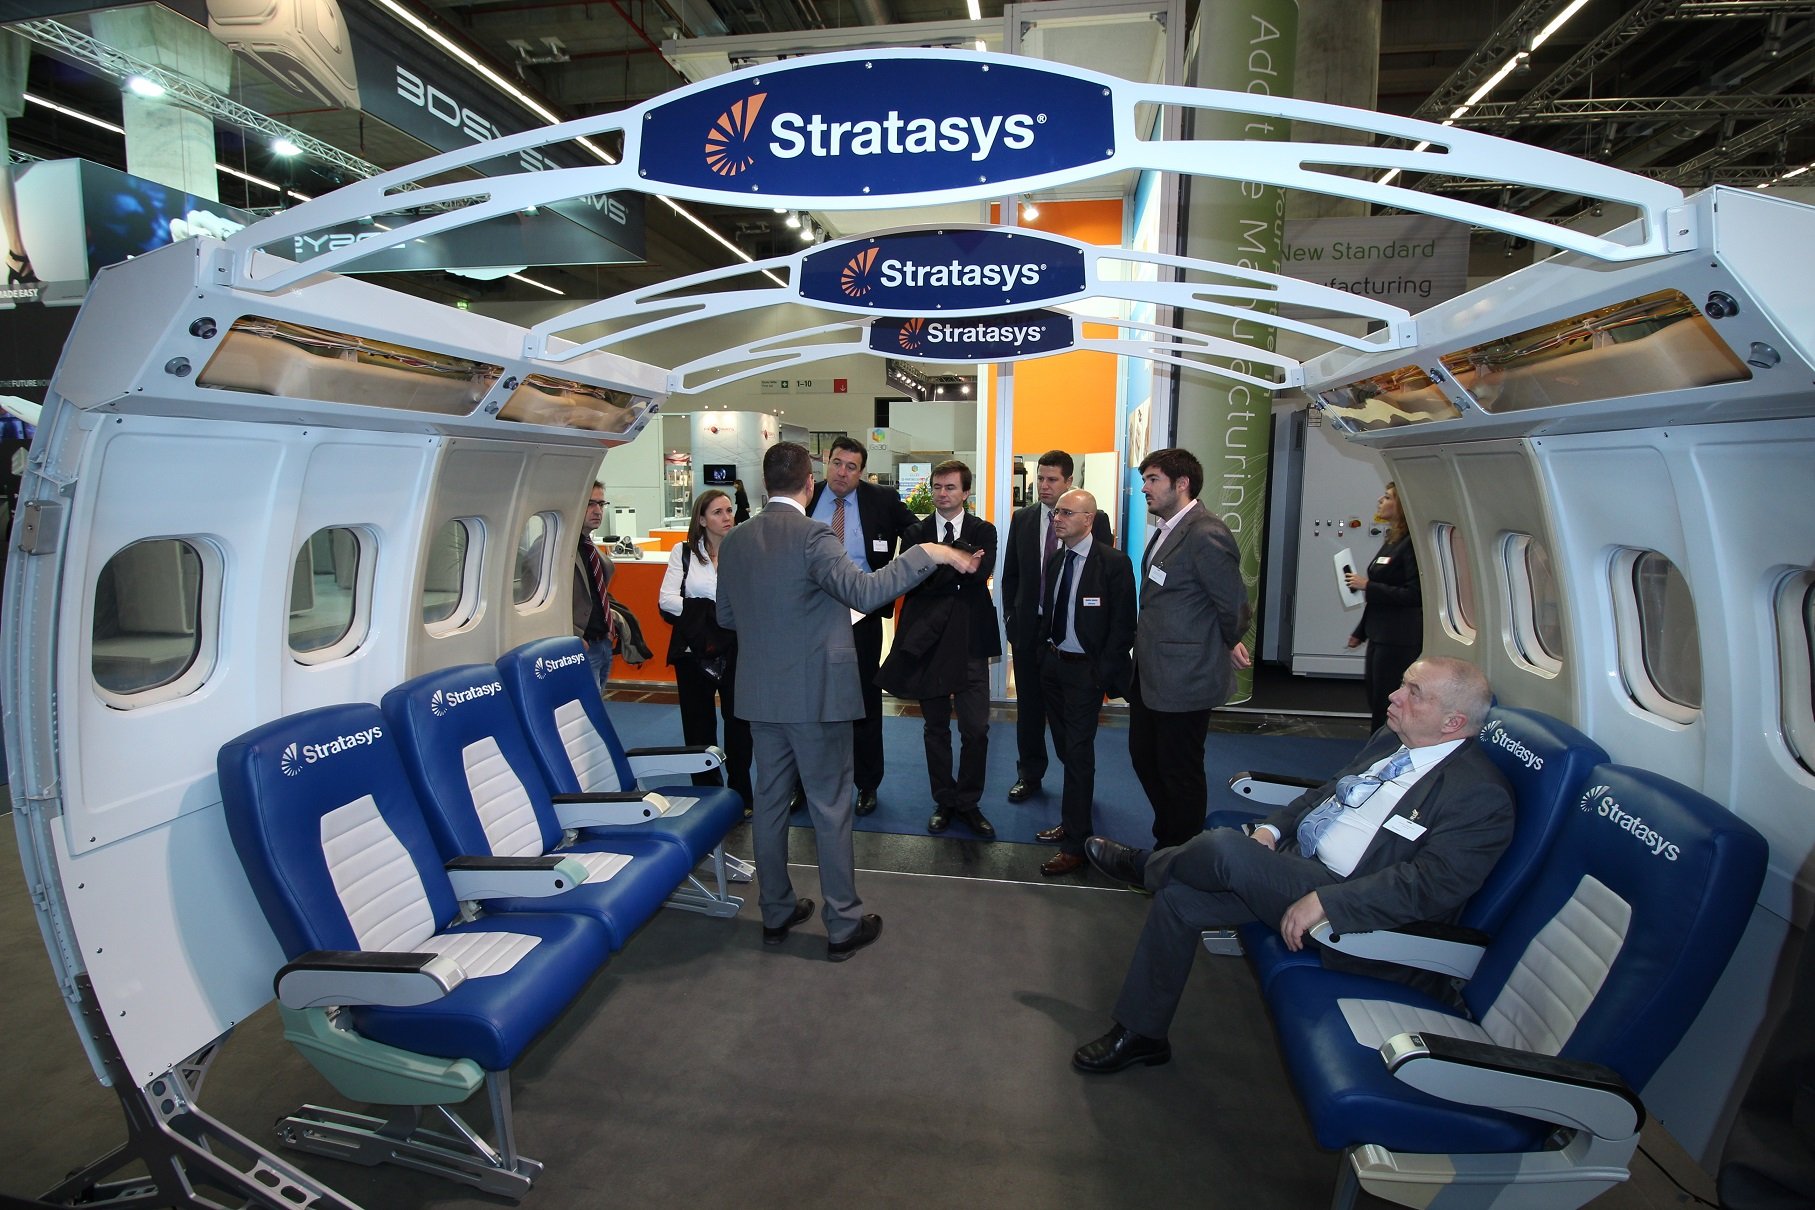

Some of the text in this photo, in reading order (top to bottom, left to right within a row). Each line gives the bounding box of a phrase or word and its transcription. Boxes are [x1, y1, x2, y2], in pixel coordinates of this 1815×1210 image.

[396, 65, 627, 225] 3DSSMS
[1281, 239, 1436, 262] New Standard
[1222, 14, 1280, 533] Adte Manuacturing
[1317, 276, 1432, 298] facturing
[19, 288, 39, 298] EASY
[545, 650, 586, 673] Stratasys
[446, 680, 502, 708] Stratasys
[302, 723, 383, 766] Stratasys
[1491, 728, 1544, 771] Stratasys
[1597, 796, 1681, 861] Stratasys
